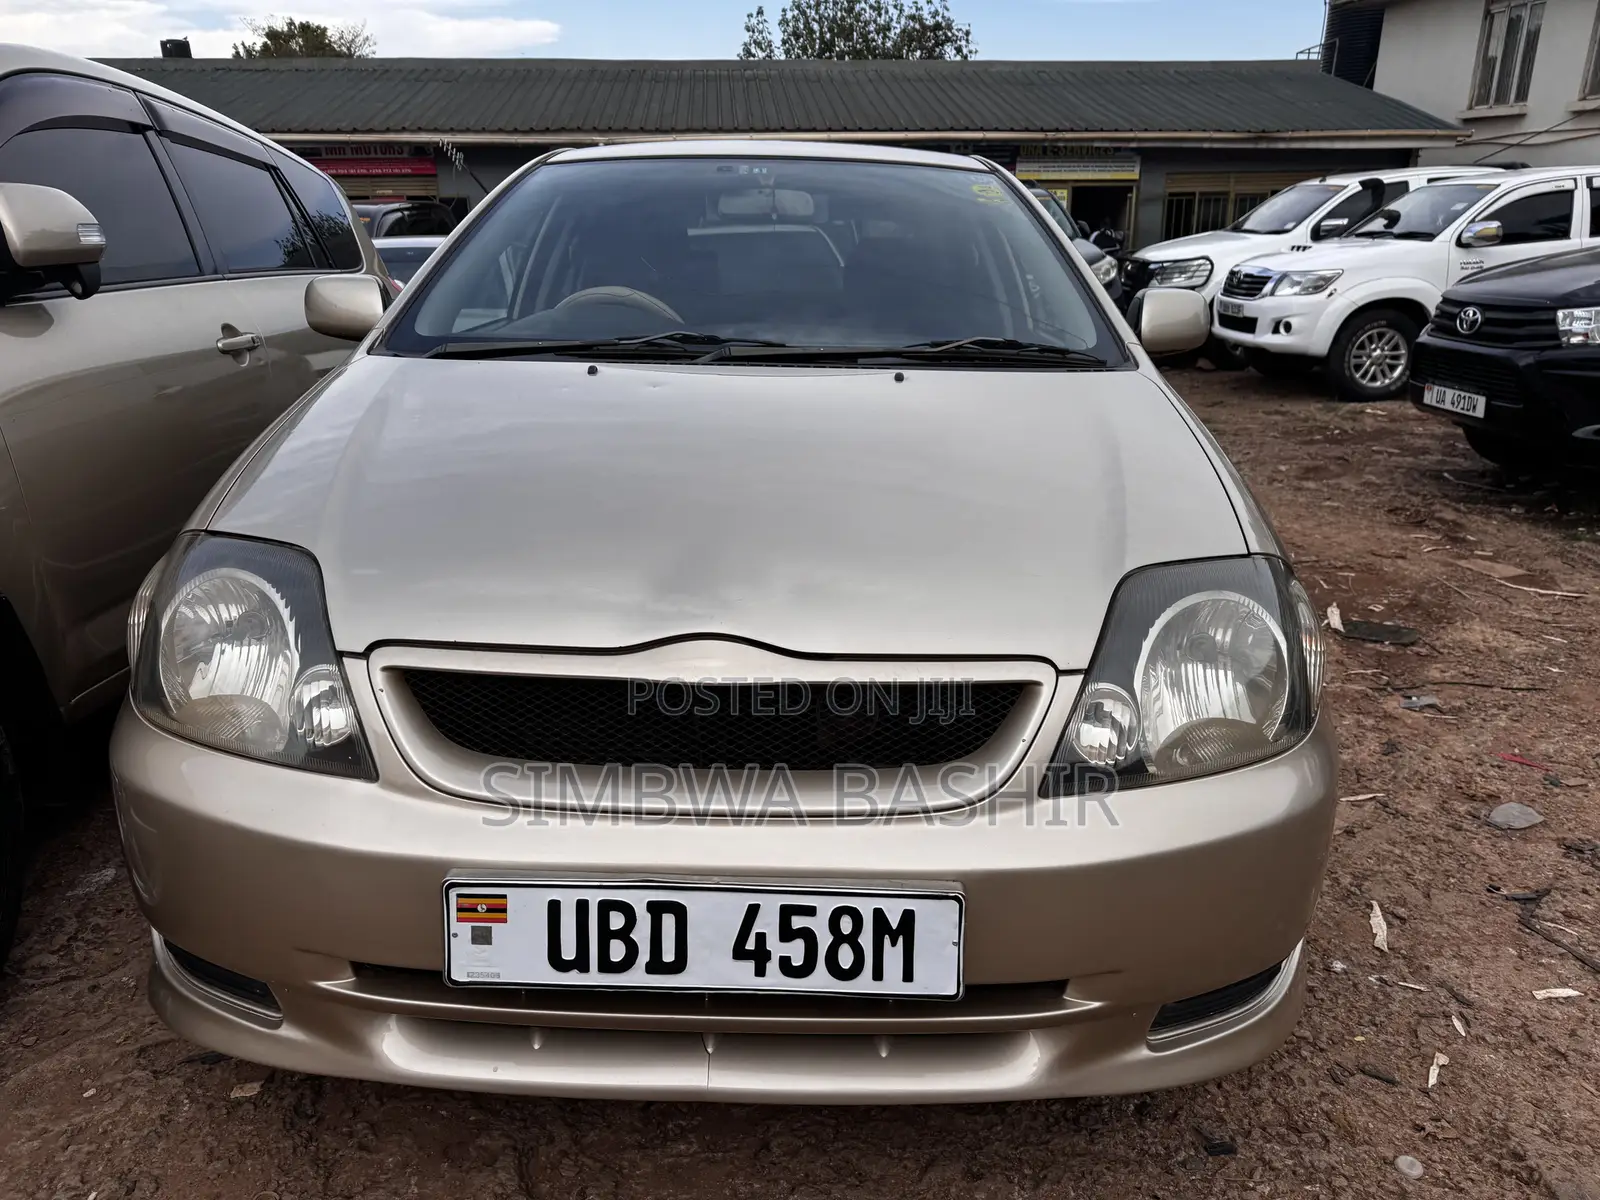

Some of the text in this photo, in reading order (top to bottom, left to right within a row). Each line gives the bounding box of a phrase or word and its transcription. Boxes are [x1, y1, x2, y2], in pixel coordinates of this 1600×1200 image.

[1436, 389, 1446, 405] UA
[547, 898, 915, 982] UBD 458M
